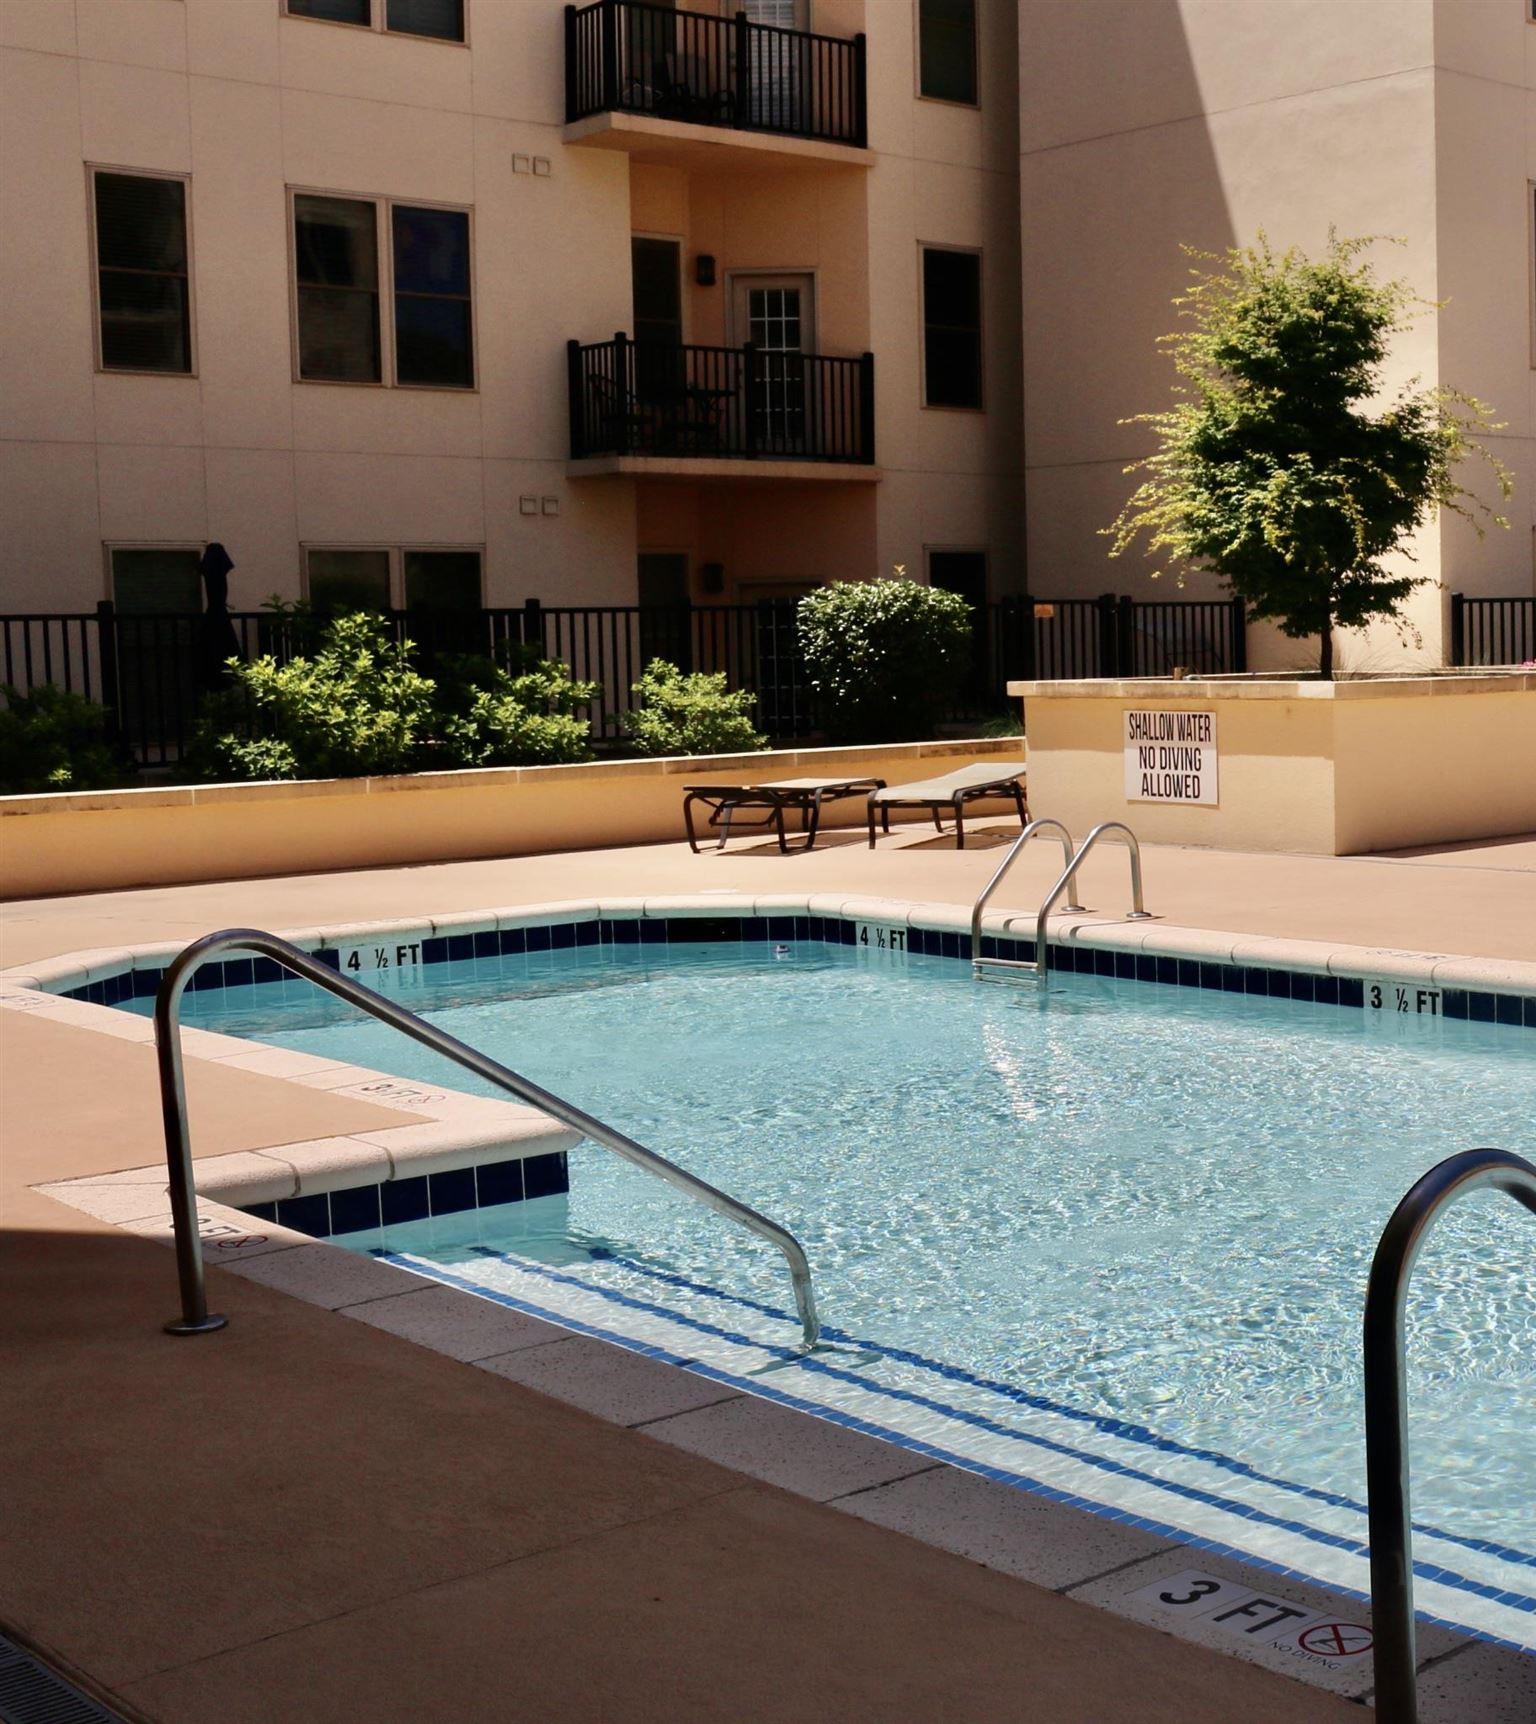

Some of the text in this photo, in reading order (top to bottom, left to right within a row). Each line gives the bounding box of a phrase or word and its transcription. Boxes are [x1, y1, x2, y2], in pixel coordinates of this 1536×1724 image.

[1129, 712, 1212, 742] SHALLOW WATER
[1139, 746, 1202, 772] NO DIVING
[1141, 772, 1201, 799] ALLOWED
[860, 926, 869, 946] 4
[889, 929, 906, 951] FT
[347, 951, 361, 971] 4
[396, 943, 420, 967] FT
[1370, 985, 1383, 1009] 3
[1416, 989, 1440, 1015] FT
[1159, 1580, 1308, 1634] 3 FT
[1270, 1640, 1342, 1671] NO DIVING
